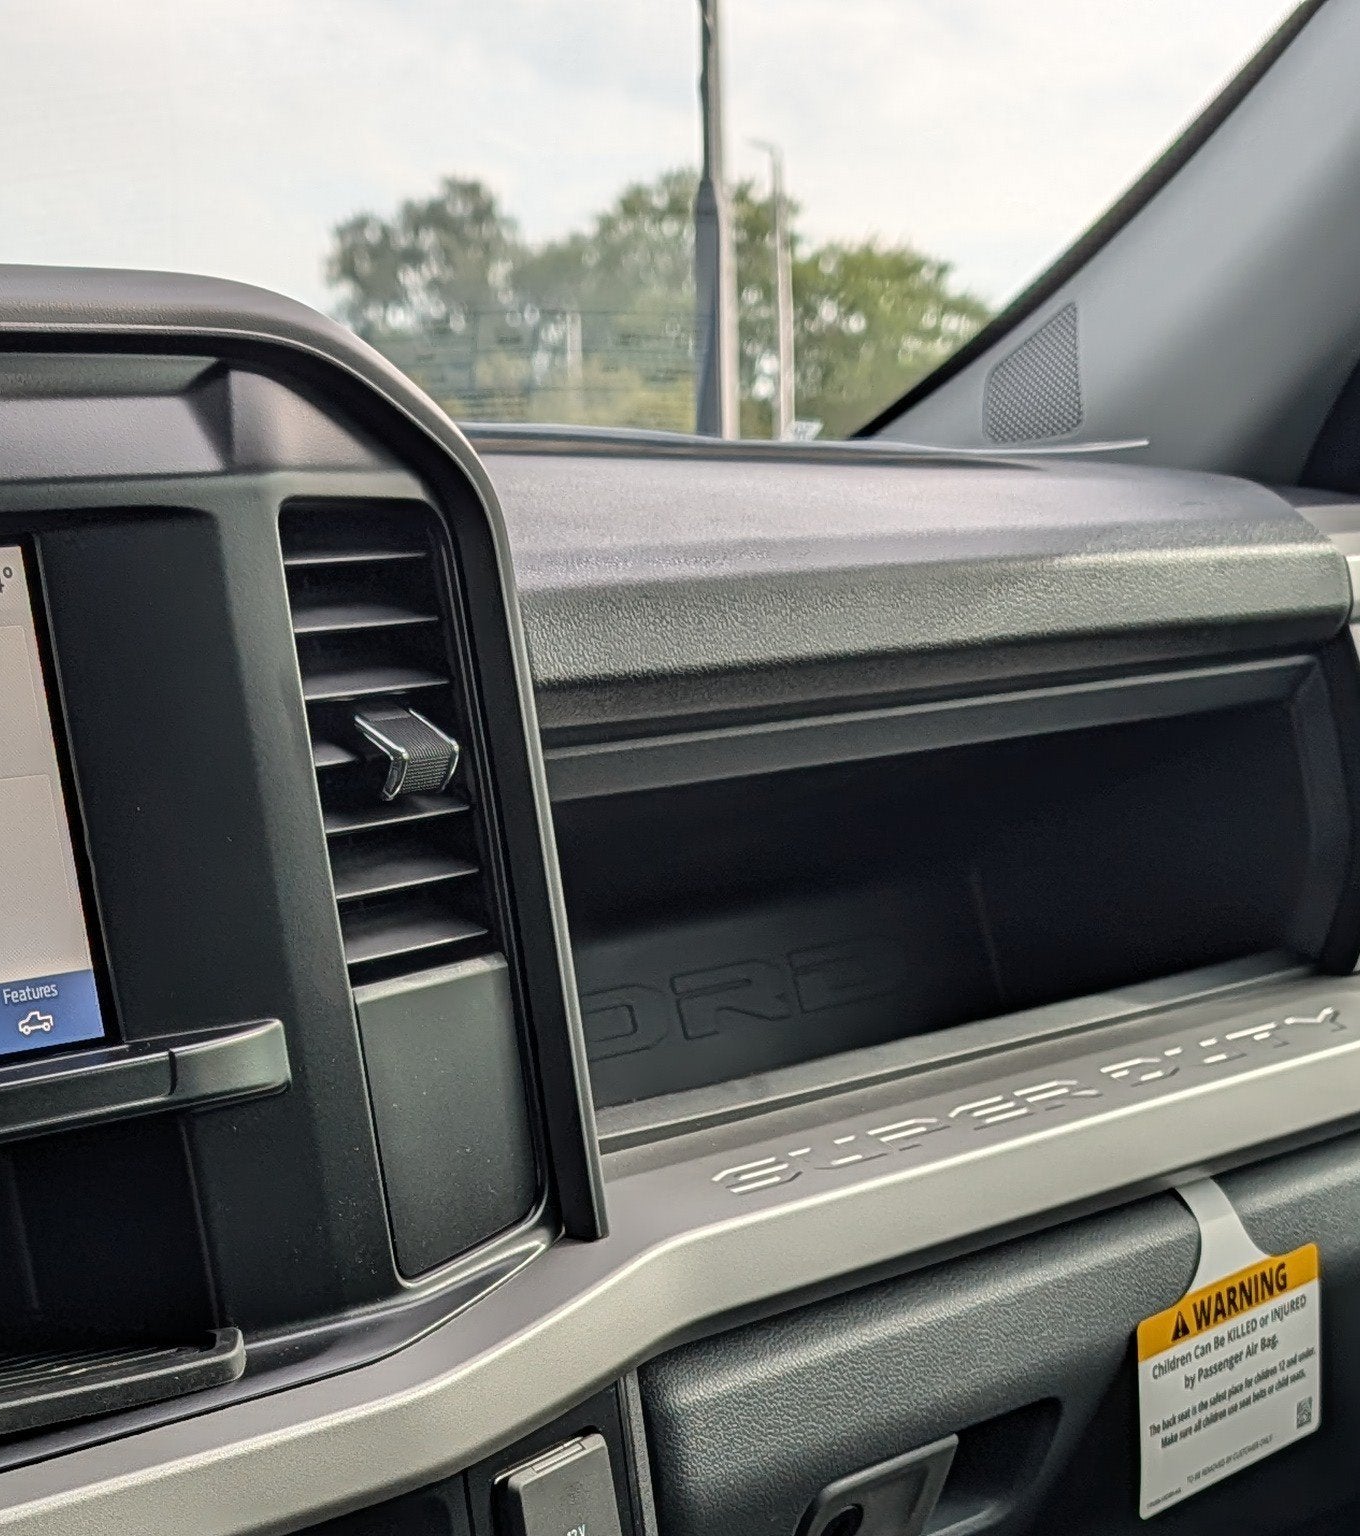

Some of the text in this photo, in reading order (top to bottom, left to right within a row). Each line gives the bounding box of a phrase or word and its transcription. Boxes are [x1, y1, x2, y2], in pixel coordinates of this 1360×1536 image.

[2, 983, 59, 1005] Features
[580, 945, 908, 1062] ORD
[711, 1005, 1347, 1195] SUPER DUTY
[1192, 1260, 1286, 1332] WARNING
[1152, 1293, 1306, 1380] Children Can Be KILLED or INJURED
[1184, 1370, 1195, 1391] by
[1198, 1347, 1243, 1383] Passenger
[1245, 1340, 1258, 1358] Air
